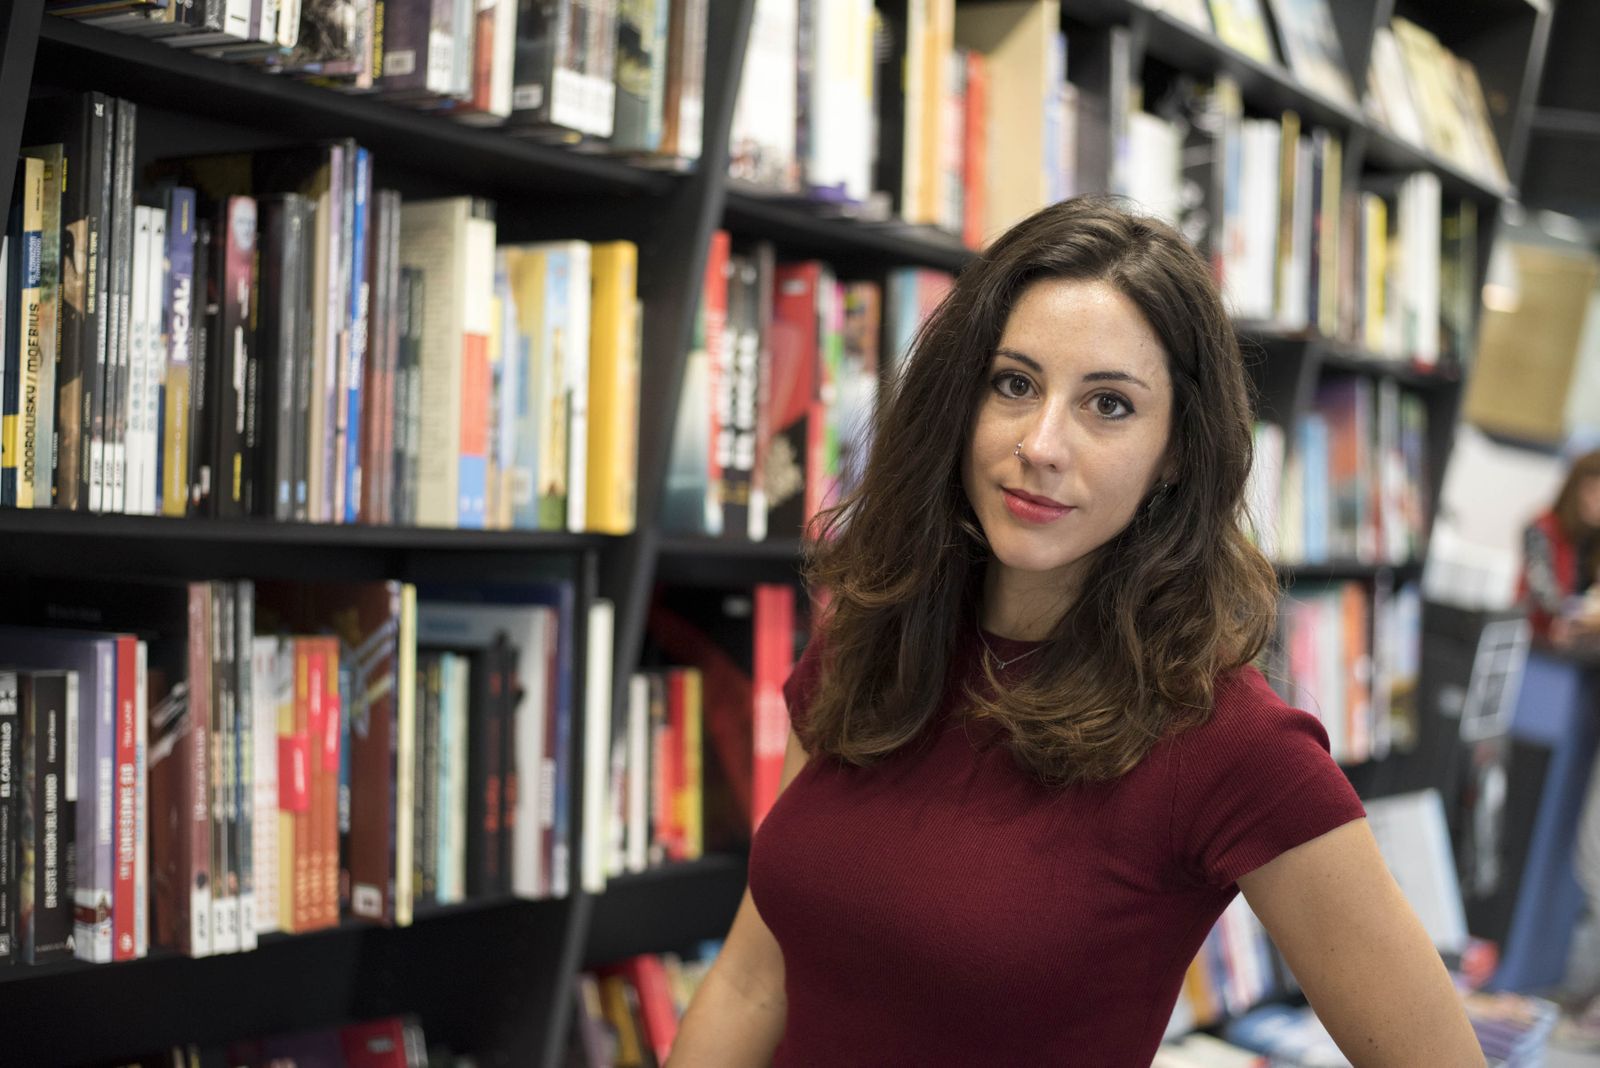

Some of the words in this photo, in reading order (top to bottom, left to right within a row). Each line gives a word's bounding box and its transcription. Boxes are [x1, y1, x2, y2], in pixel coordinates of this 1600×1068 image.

[27, 303, 42, 373] MOEBIUS
[24, 385, 35, 488] JODOROWSKY
[1, 722, 12, 782] CASTILLO
[45, 773, 58, 811] MUNDO
